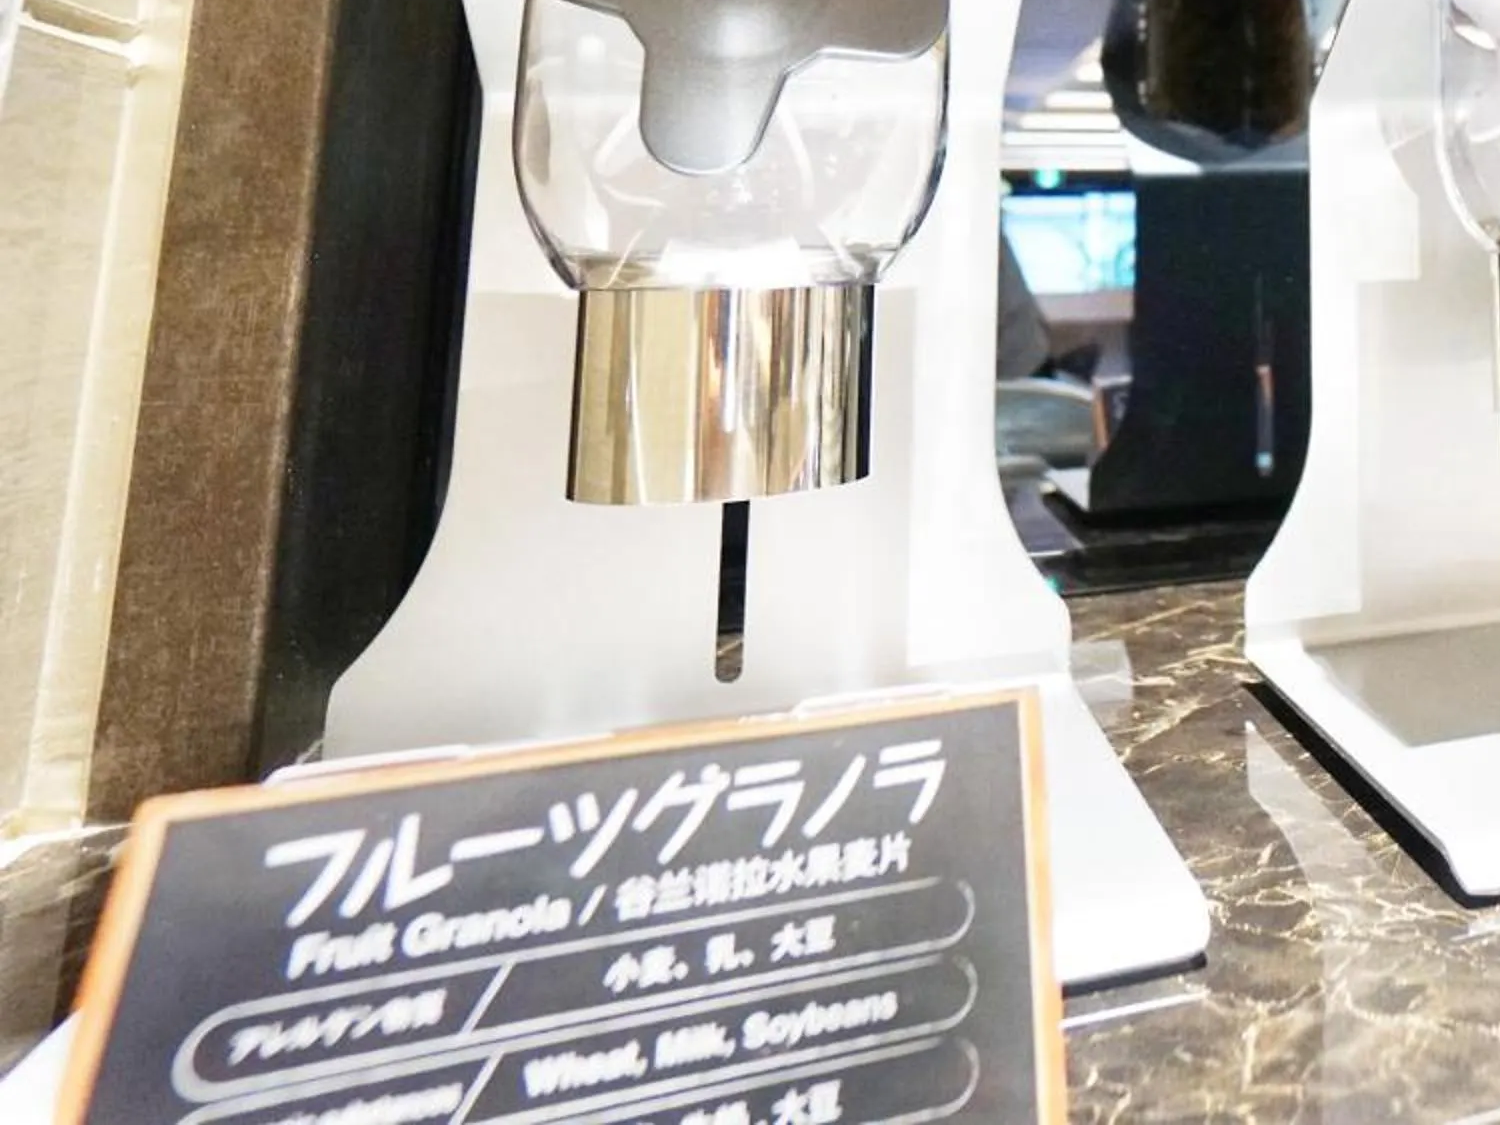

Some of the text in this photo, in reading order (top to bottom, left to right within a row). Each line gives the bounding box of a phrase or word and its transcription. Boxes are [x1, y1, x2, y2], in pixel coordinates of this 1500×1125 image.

[264, 739, 946, 928] フルーツグラノラ
[286, 921, 398, 981] Fruit
[402, 894, 572, 958] Granola
